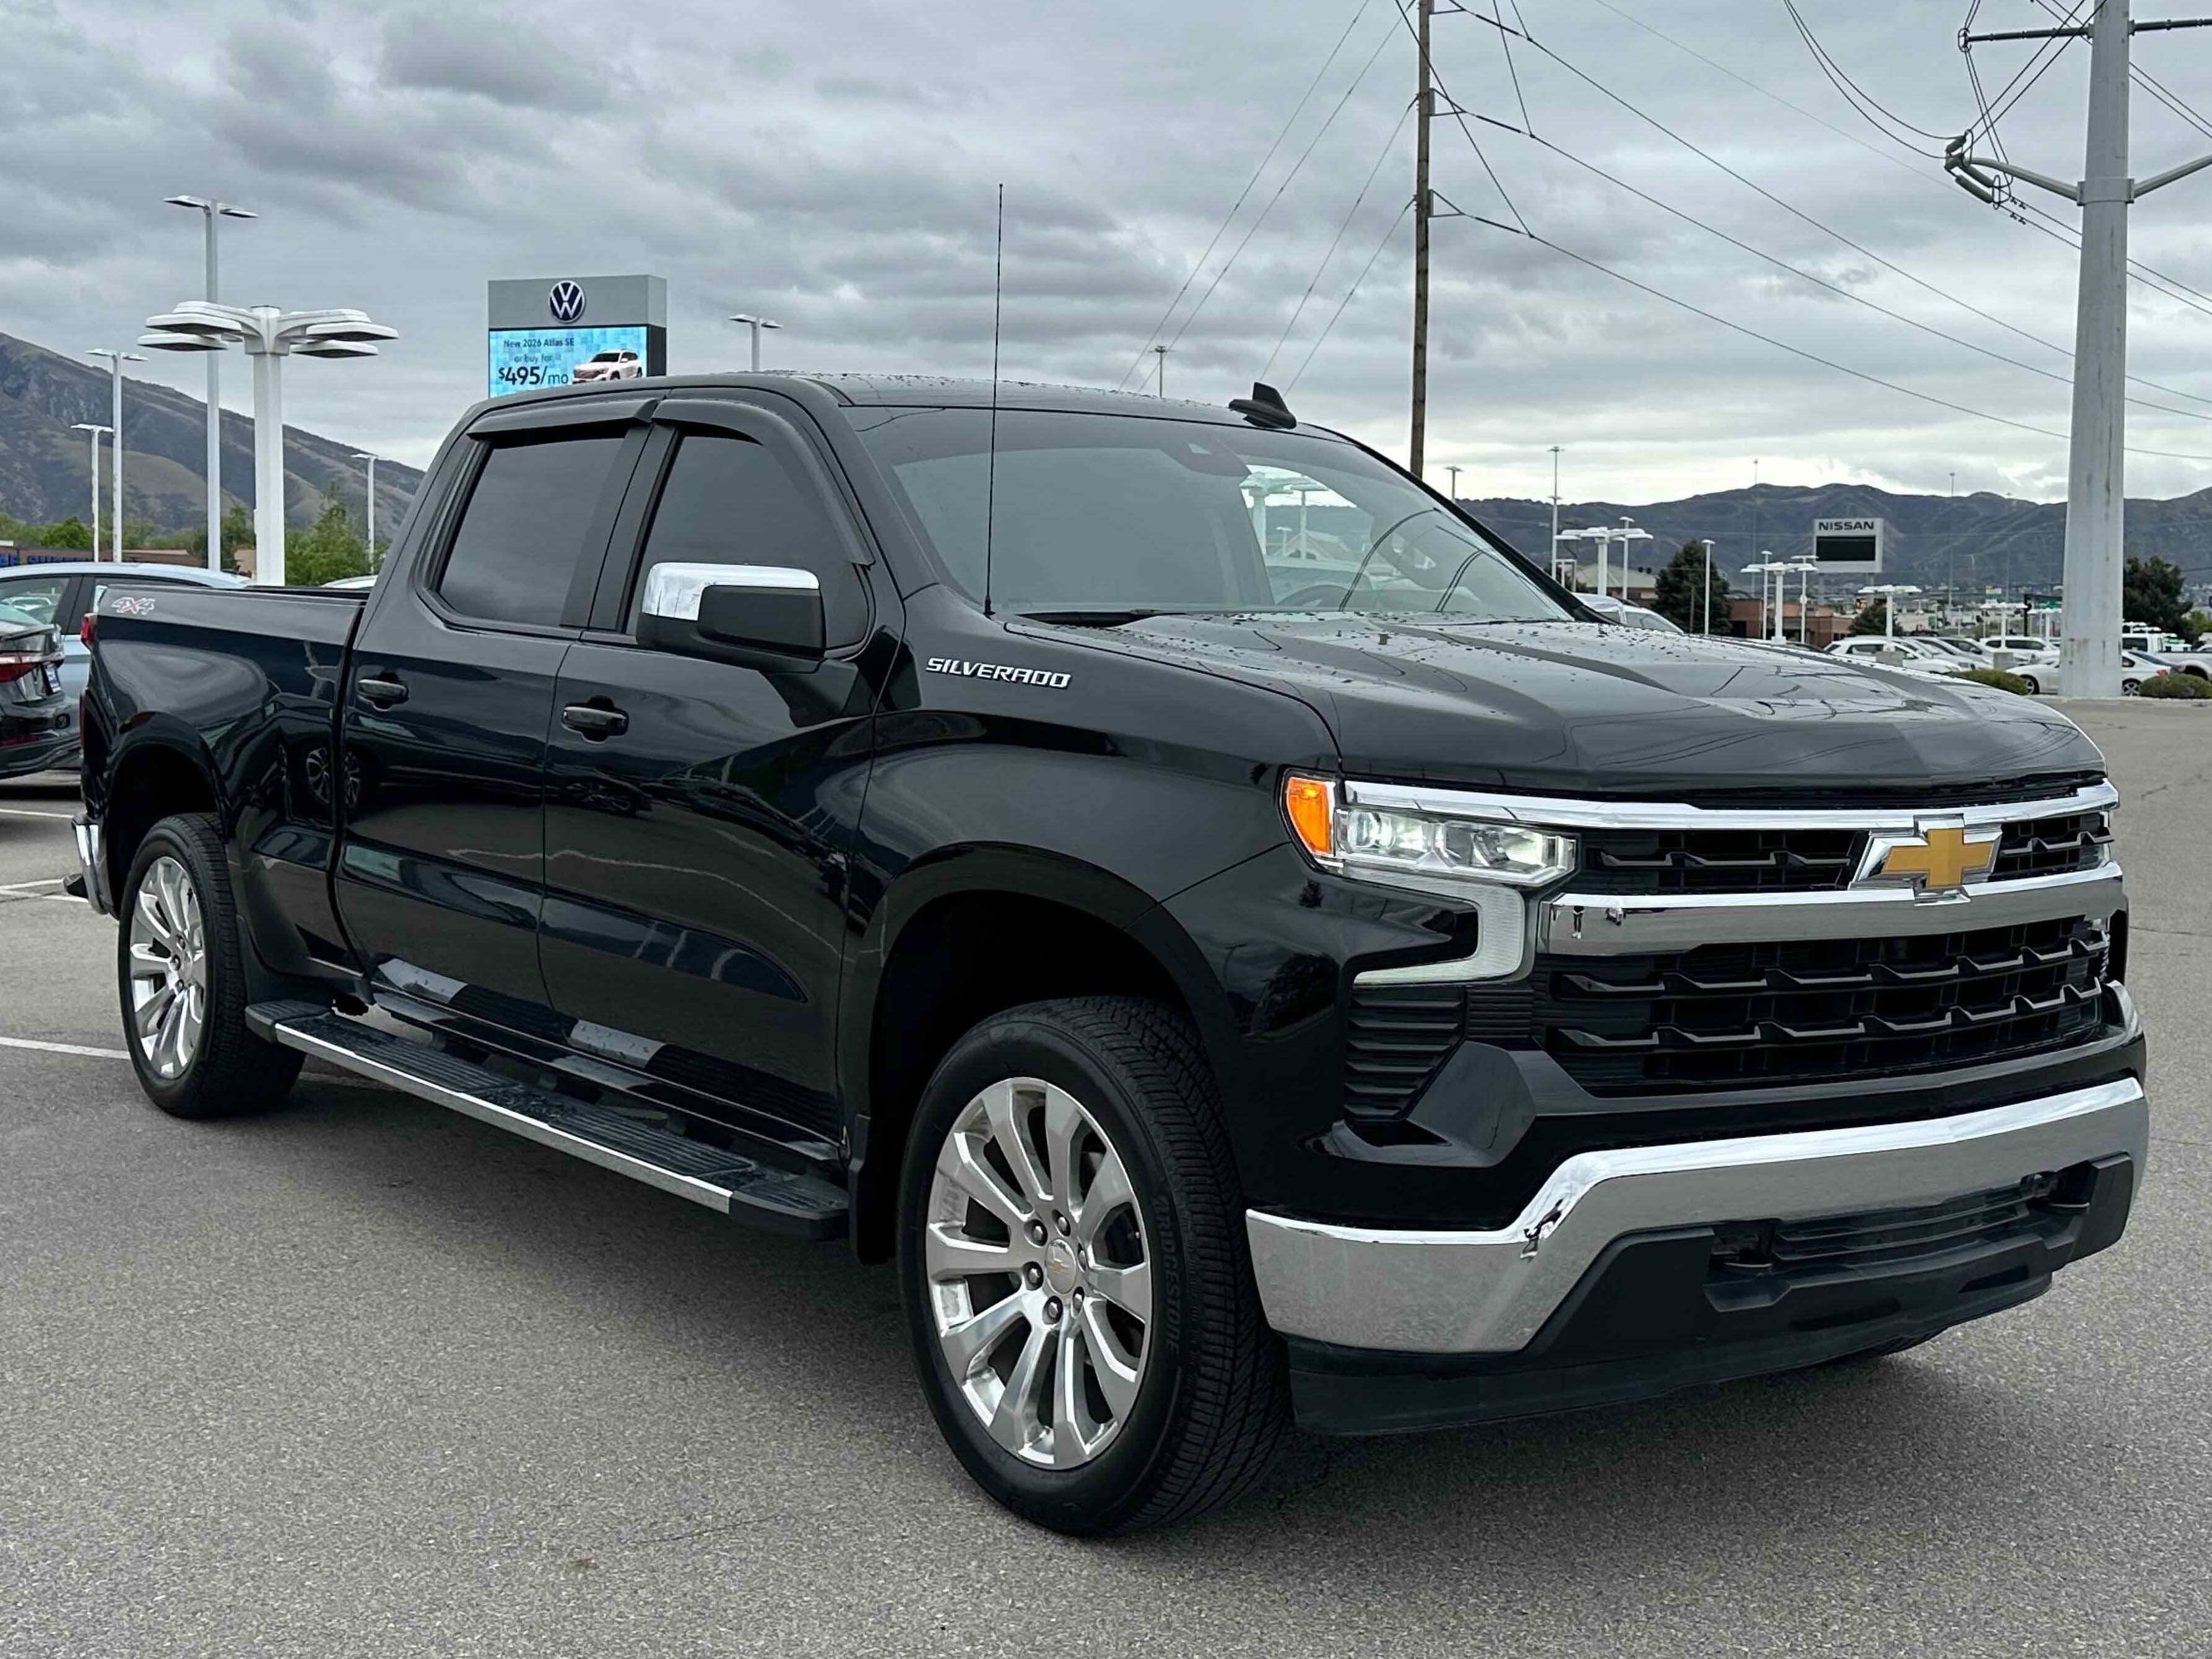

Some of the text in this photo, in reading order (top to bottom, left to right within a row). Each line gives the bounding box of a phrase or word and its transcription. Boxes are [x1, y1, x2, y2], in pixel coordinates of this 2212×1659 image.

[504, 337, 575, 347] New 2026 Atlas SE
[524, 355, 539, 363] buy
[541, 353, 553, 362] for
[498, 366, 568, 385] $495/mo
[1818, 521, 1875, 531] NISSAN
[926, 657, 1072, 689] SILVERADO
